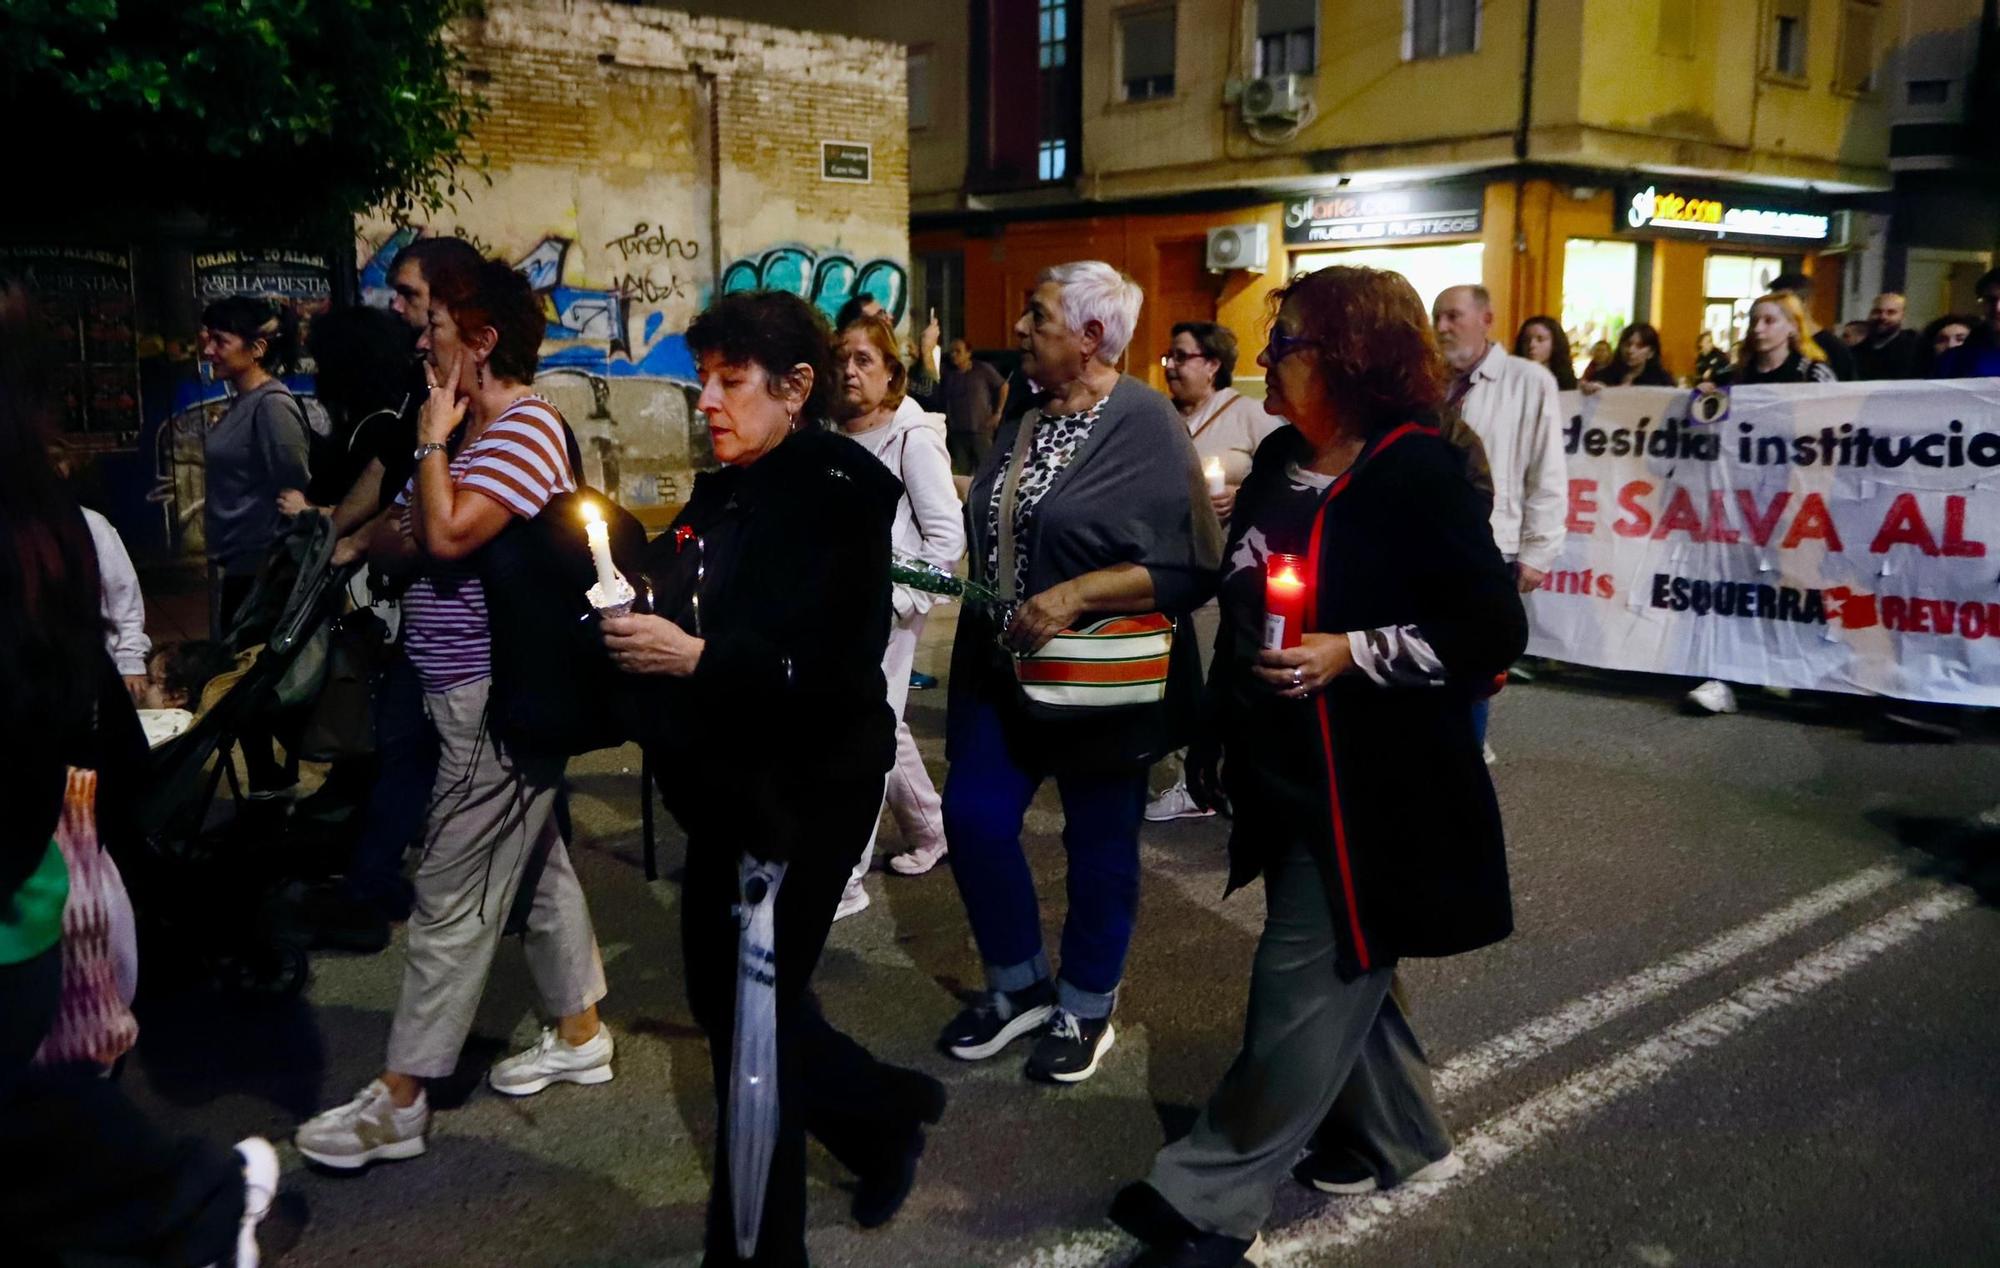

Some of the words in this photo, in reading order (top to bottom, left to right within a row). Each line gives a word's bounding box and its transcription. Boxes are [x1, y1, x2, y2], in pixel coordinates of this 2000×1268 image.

[1611, 480, 1843, 554] SALVA
[1868, 492, 1986, 558] AL
[1651, 573, 1827, 626] ESQUERRA
